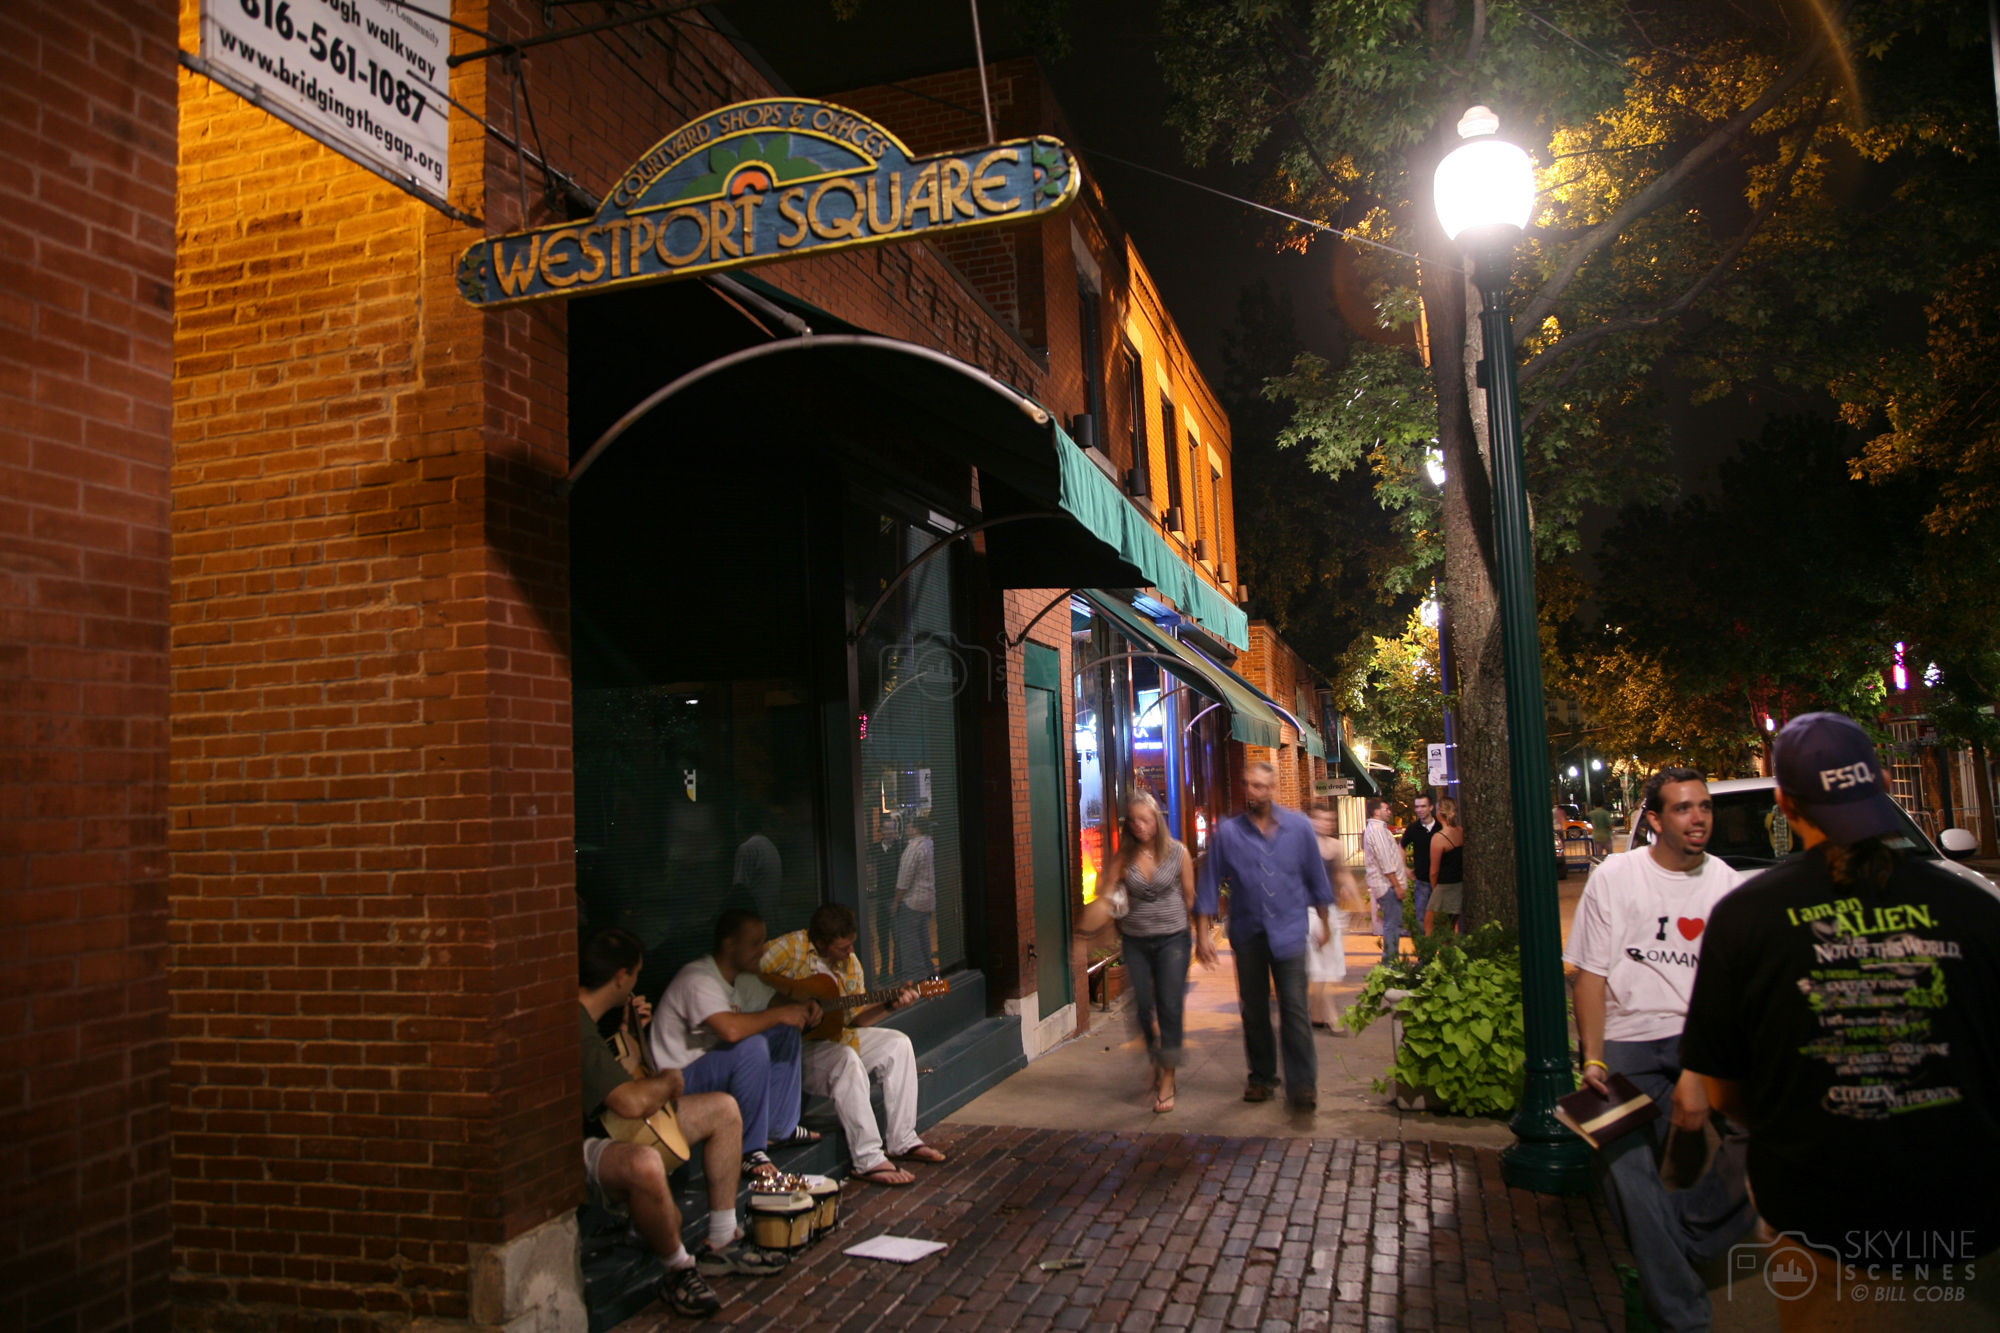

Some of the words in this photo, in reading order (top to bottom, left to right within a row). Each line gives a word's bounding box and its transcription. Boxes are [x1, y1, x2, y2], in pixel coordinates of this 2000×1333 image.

[366, 17, 436, 82] walkway
[219, 28, 443, 181] www.bridgingthegap.org
[613, 122, 711, 208] COURTYARD
[718, 104, 783, 134] SHOPS
[812, 108, 891, 159] OFFICES
[493, 192, 766, 297] WESTPORT
[778, 149, 1021, 249] SQUARE
[1328, 783, 1347, 791] drops
[1656, 916, 1669, 941] I
[1786, 908, 1800, 927] I
[1800, 903, 1834, 923] am
[1834, 897, 1863, 914] an
